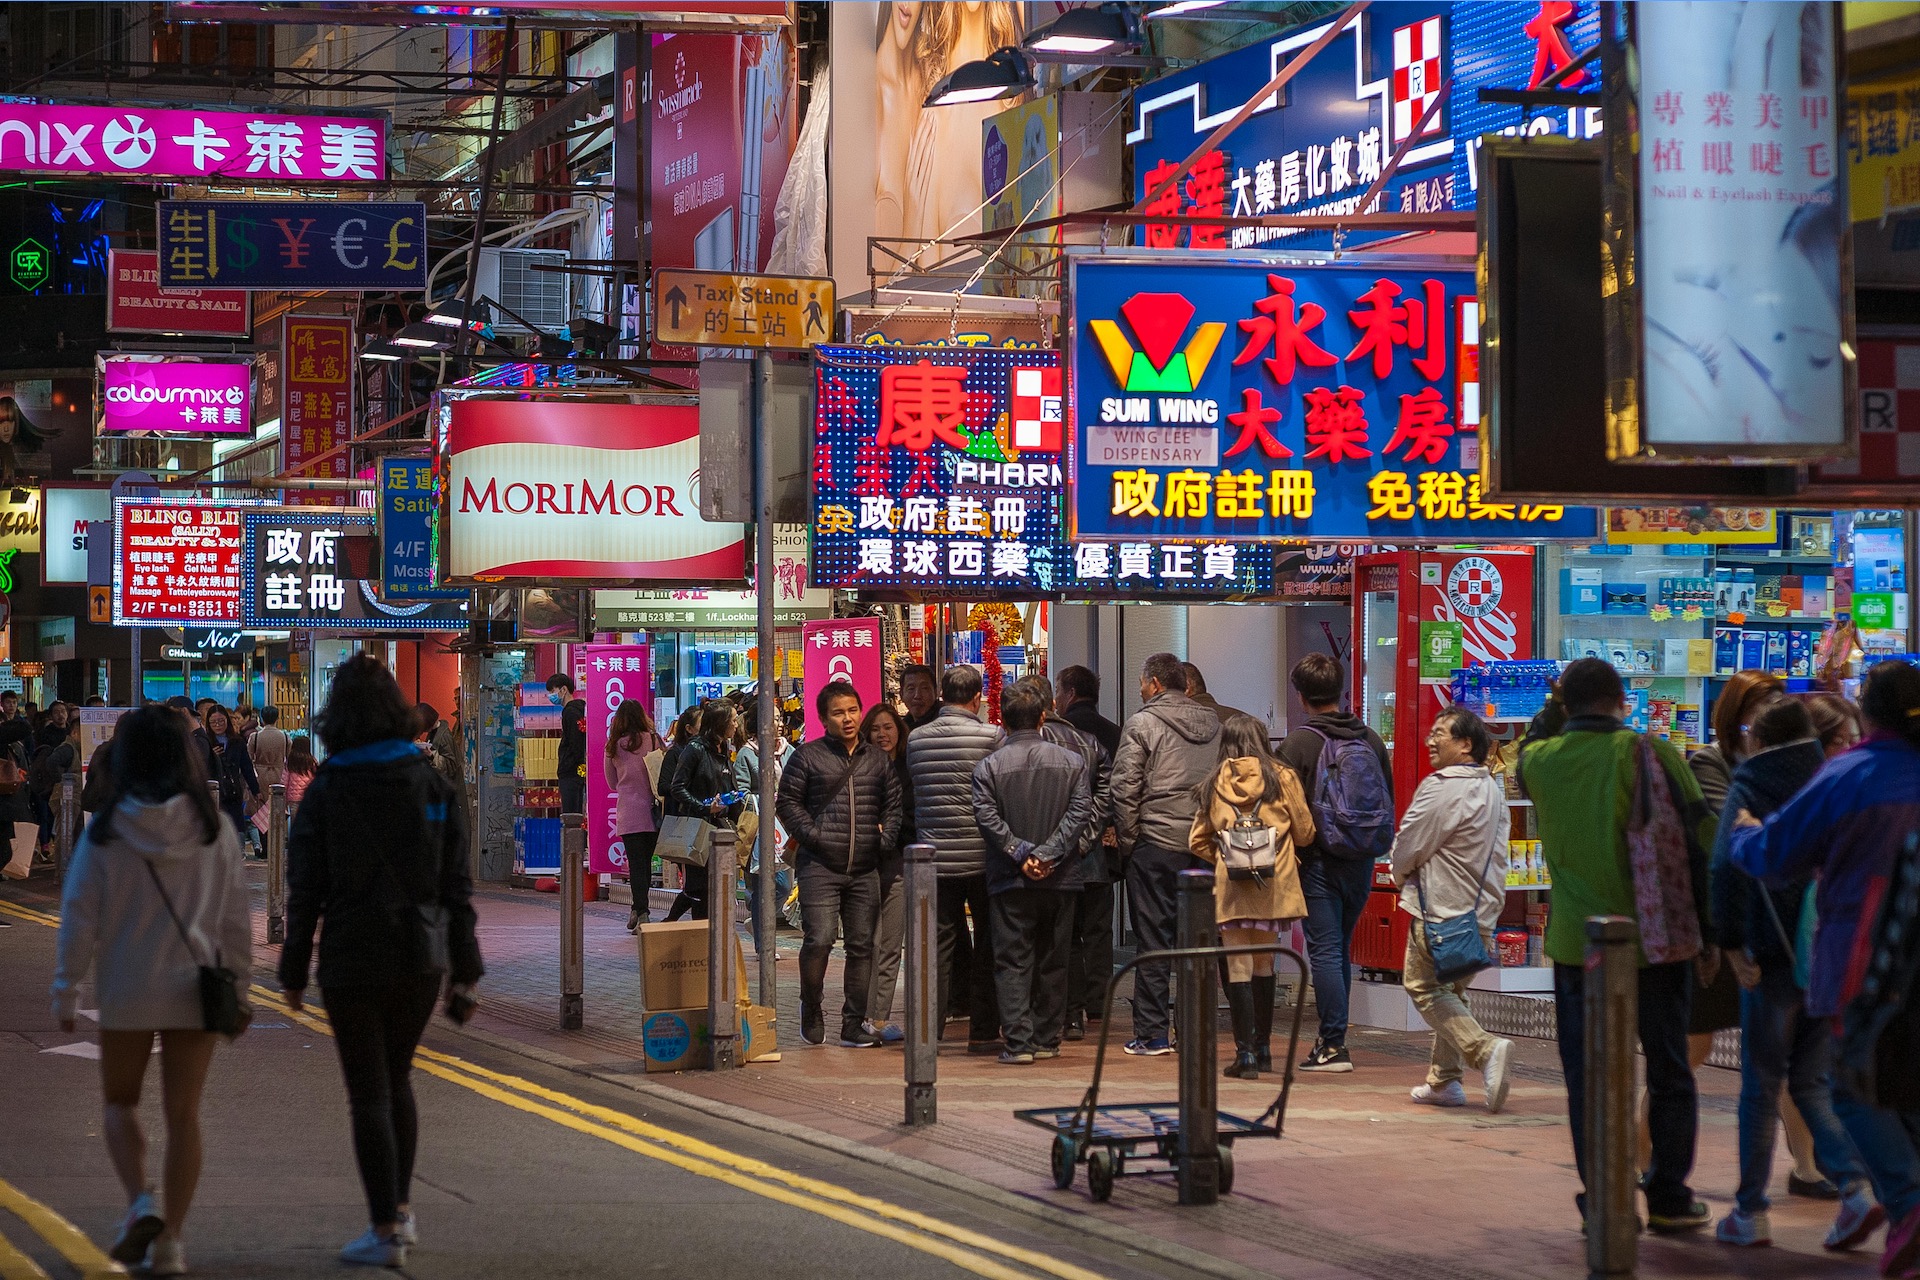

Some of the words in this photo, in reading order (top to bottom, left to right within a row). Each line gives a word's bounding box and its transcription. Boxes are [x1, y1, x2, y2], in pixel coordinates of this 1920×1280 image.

[1651, 89, 1831, 131] 專業美甲
[173, 118, 378, 179] 卡萊美
[1652, 137, 1832, 178] 植眼睫毛
[1400, 173, 1456, 214] 有限公司
[694, 284, 733, 302] Taxi
[741, 286, 798, 306] Stand
[704, 309, 786, 337] 的士站
[1232, 273, 1446, 385] 永利
[179, 406, 242, 424] 卡萊美
[876, 359, 971, 450] 康
[1101, 398, 1150, 423] SUM
[1158, 398, 1219, 424] WING
[1223, 385, 1456, 465] 大藥房
[1114, 431, 1157, 444] WING
[1164, 431, 1191, 444] LEE
[1104, 447, 1203, 461] DISPENSARY
[1112, 468, 1317, 519] 政府註冊
[130, 509, 193, 524] BLING
[858, 495, 1028, 533] 政府註冊
[130, 536, 200, 546] BEAUTY
[171, 525, 221, 538] (SALLY)
[393, 541, 425, 558] 4/F
[858, 540, 1029, 579] 環球西藥
[1073, 542, 1238, 580] 優質正貨
[265, 573, 345, 610] 註冊
[131, 602, 156, 614] 2/F
[160, 603, 187, 613] Tel:
[188, 600, 222, 609] 9251
[188, 609, 223, 617] 9604
[790, 612, 807, 621] 523
[809, 629, 873, 649] 卡萊美
[590, 656, 642, 673] 卡萊美
